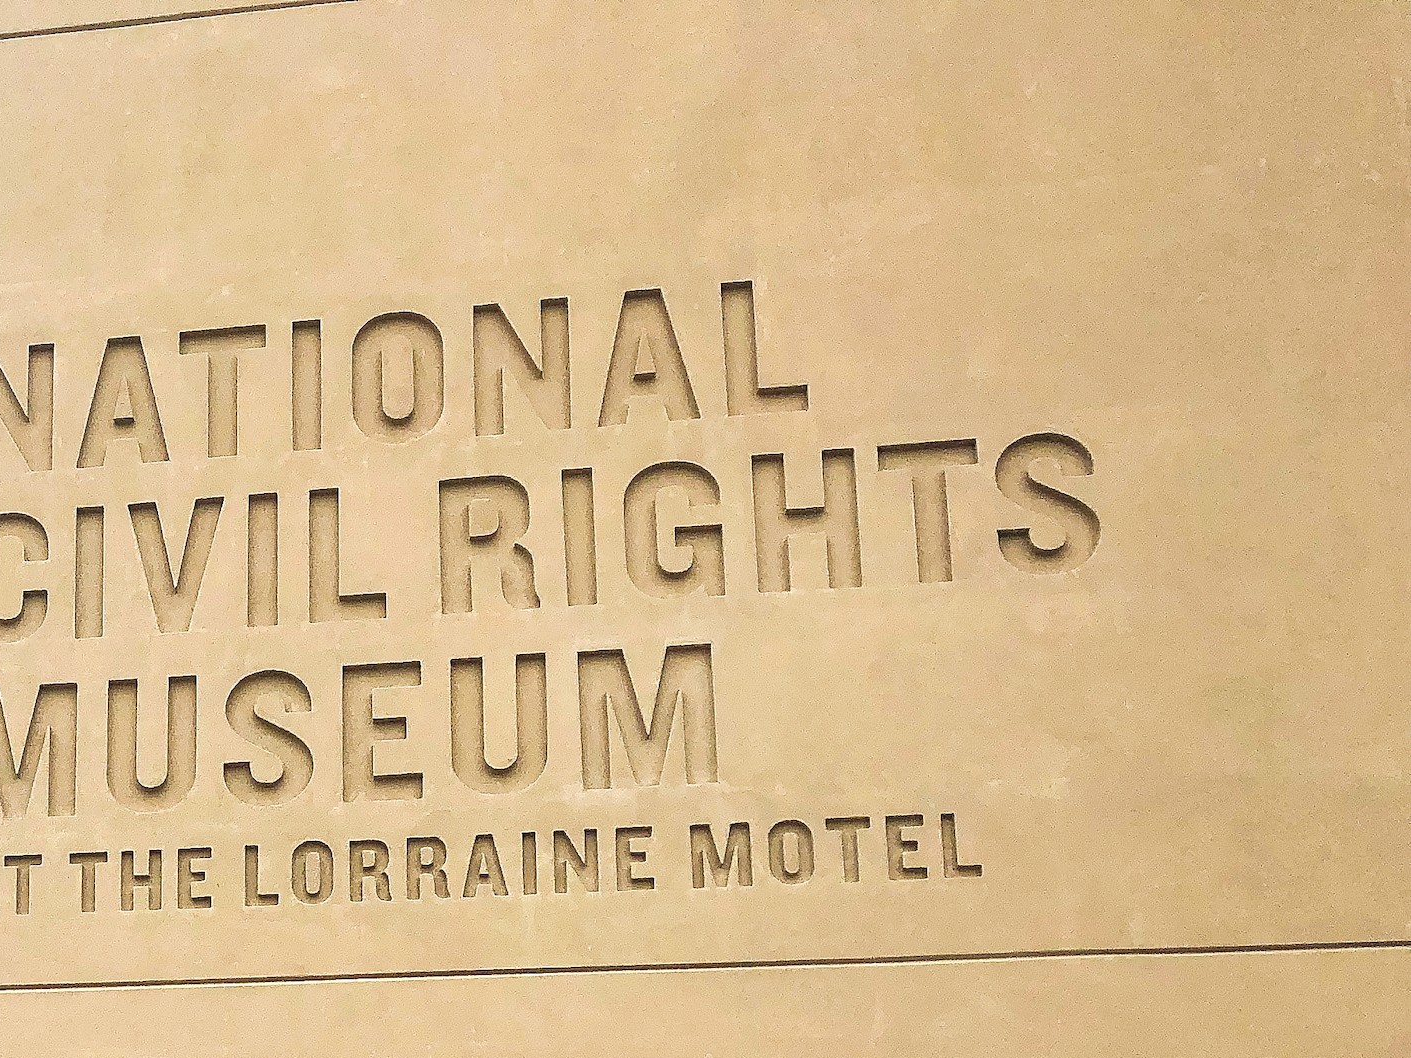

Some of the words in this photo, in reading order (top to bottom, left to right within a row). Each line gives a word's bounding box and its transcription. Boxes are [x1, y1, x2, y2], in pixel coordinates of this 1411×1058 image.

[437, 431, 1102, 612] RIGHTS
[69, 846, 214, 915] THE
[244, 825, 655, 907] LORRAINE
[691, 813, 983, 890] MOTEL
